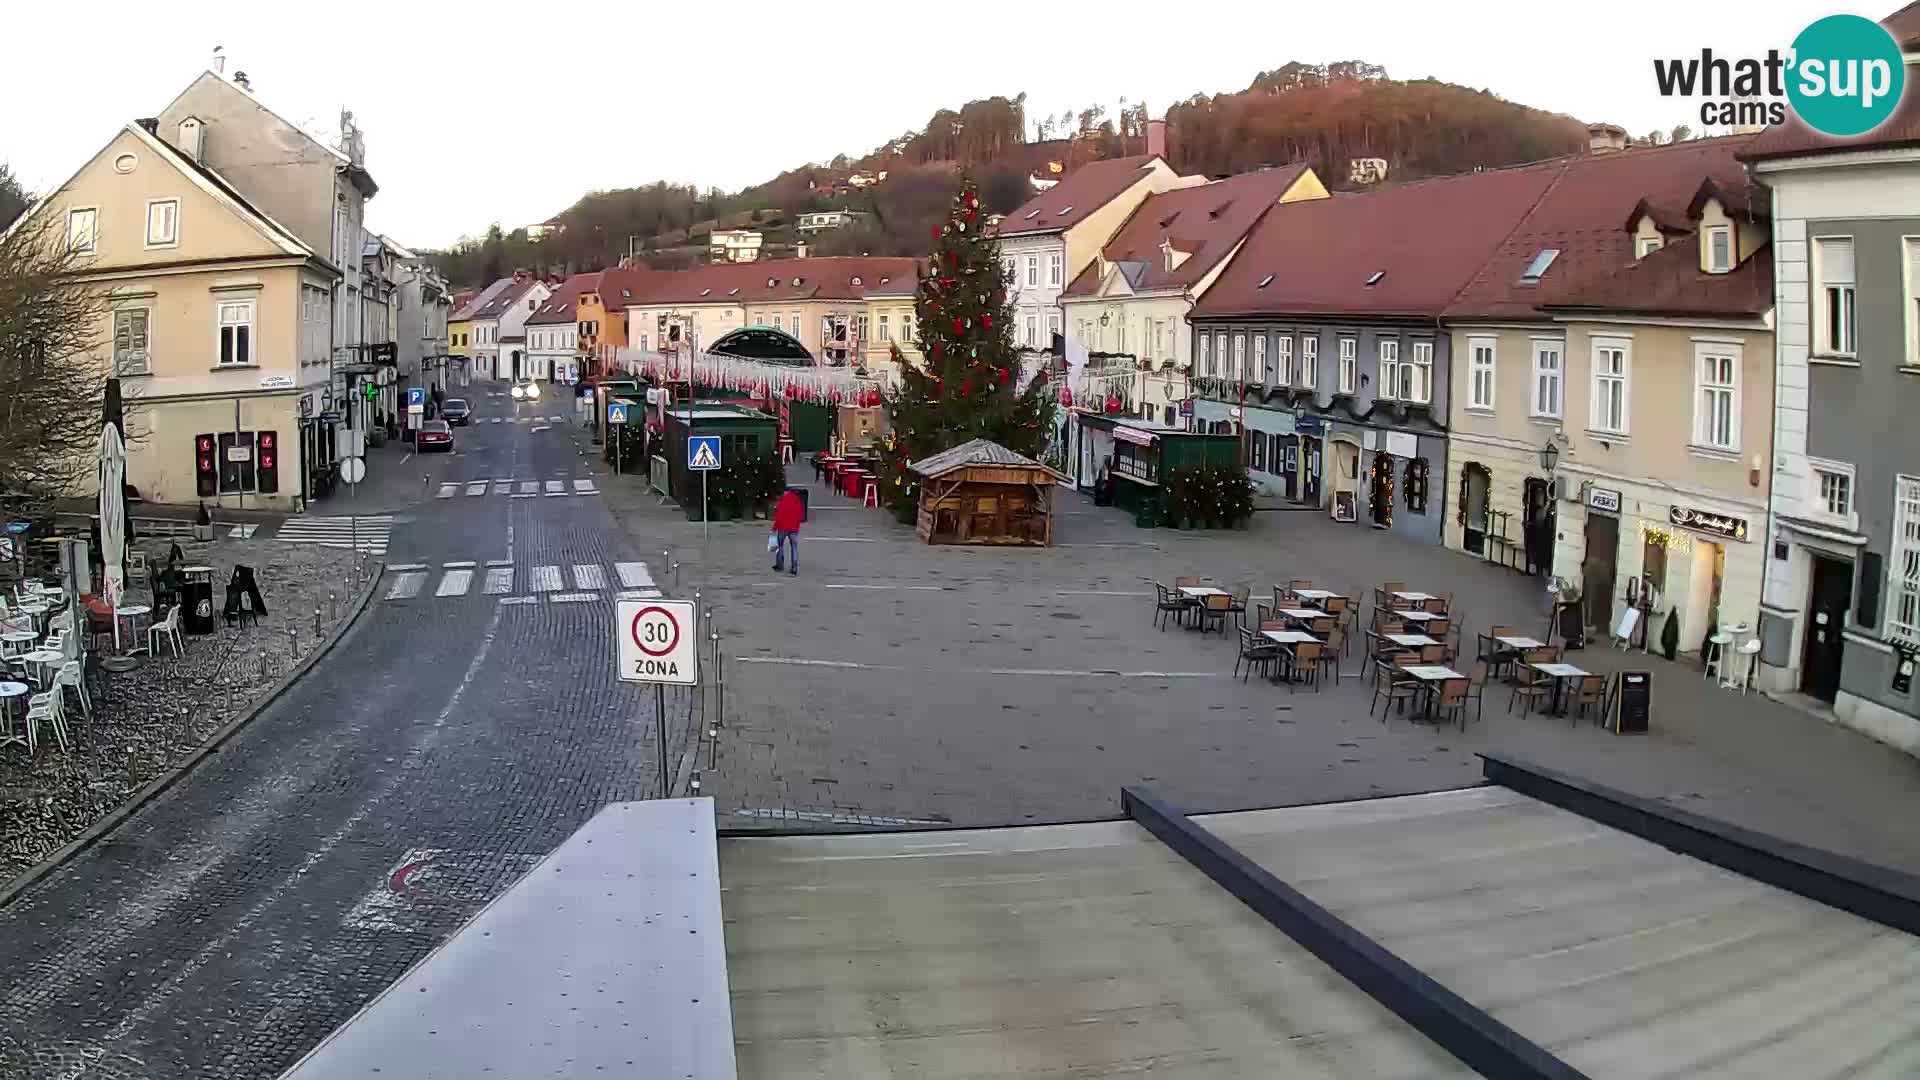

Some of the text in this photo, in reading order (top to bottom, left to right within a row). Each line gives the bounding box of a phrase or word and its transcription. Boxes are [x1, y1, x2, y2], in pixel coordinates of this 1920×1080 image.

[412, 391, 420, 402] P
[645, 622, 668, 643] 30
[635, 659, 679, 676] ZONA
